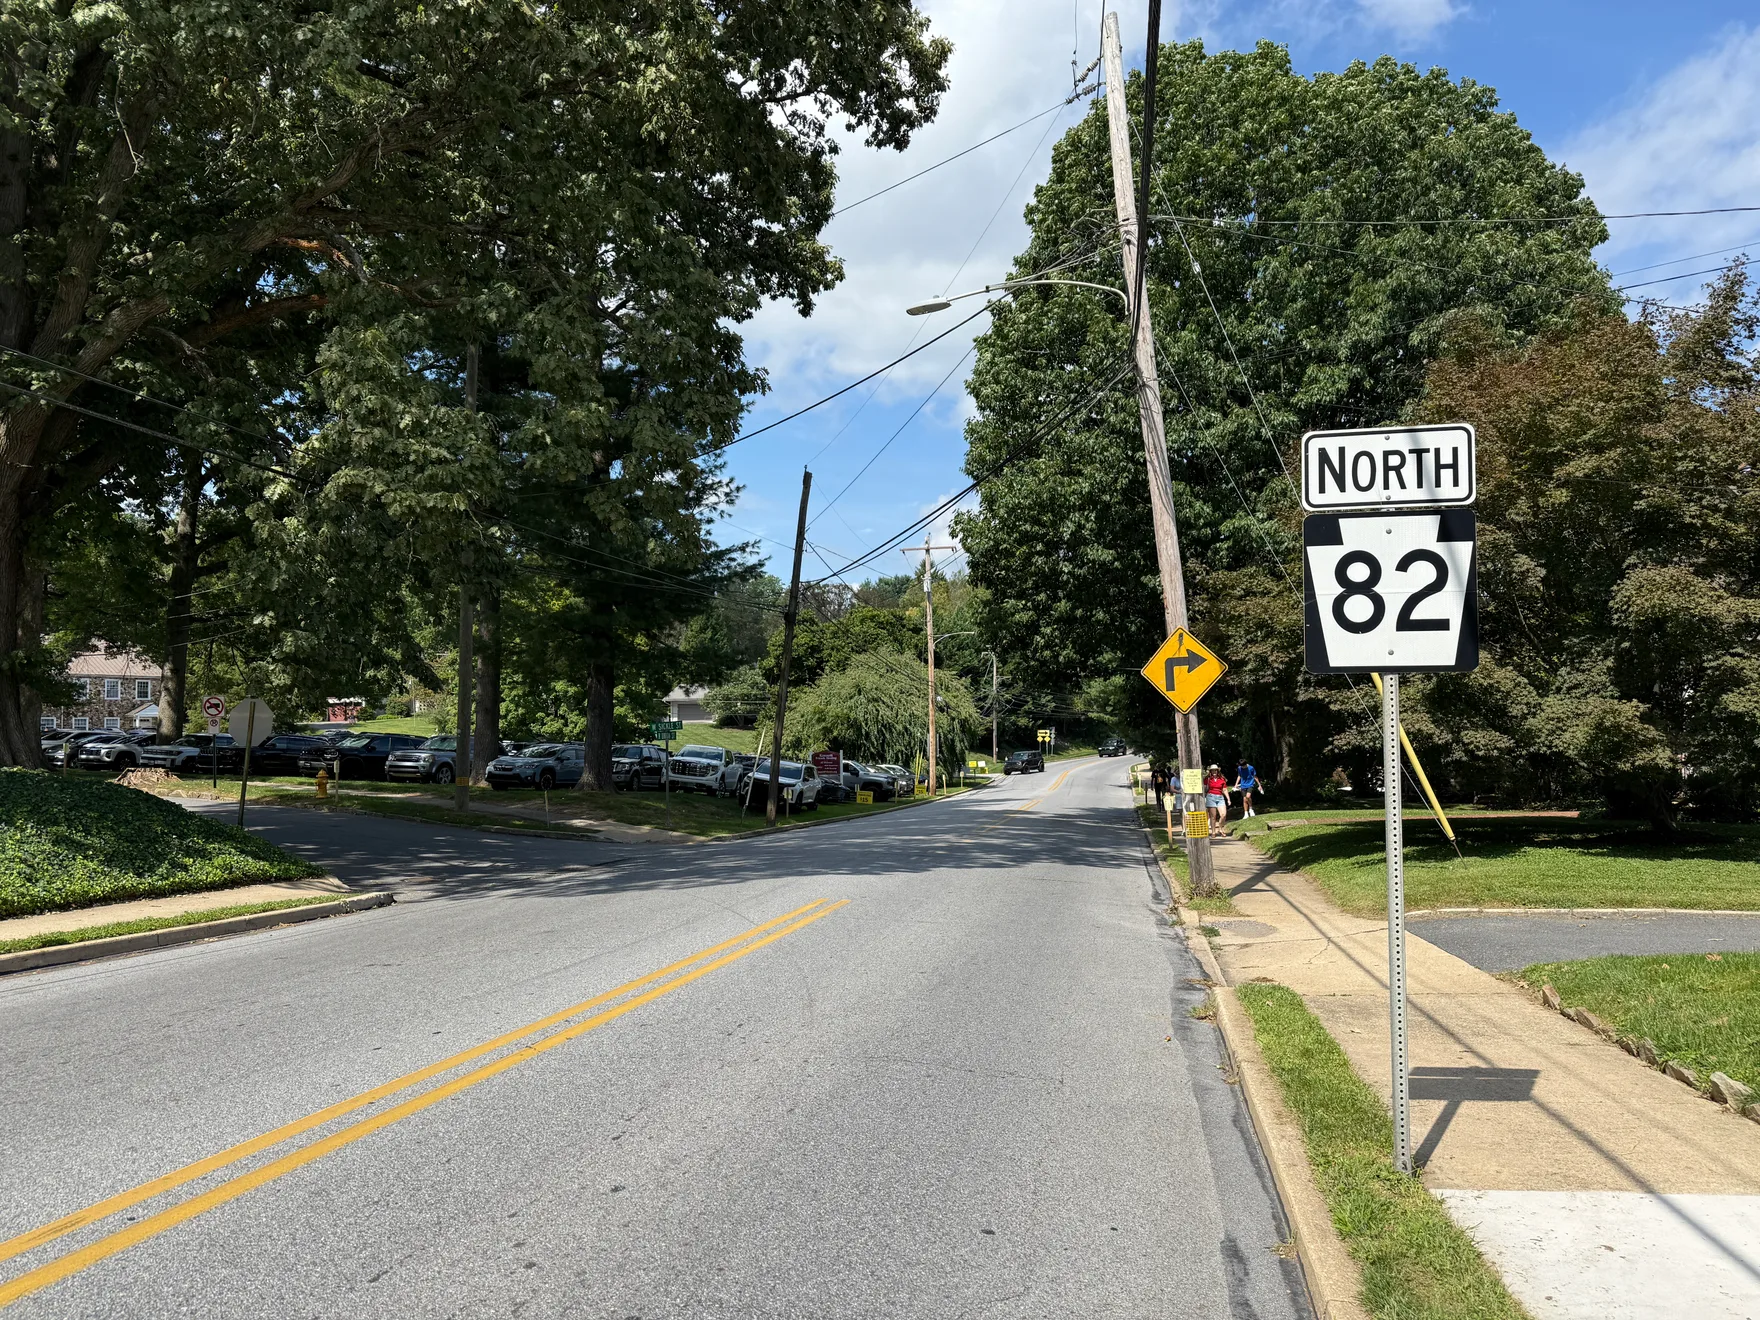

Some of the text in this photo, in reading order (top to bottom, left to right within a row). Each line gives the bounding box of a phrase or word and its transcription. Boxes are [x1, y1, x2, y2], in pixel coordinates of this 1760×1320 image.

[1317, 446, 1459, 494] NORTH
[1331, 548, 1450, 634] 82
[676, 721, 681, 729] ST
